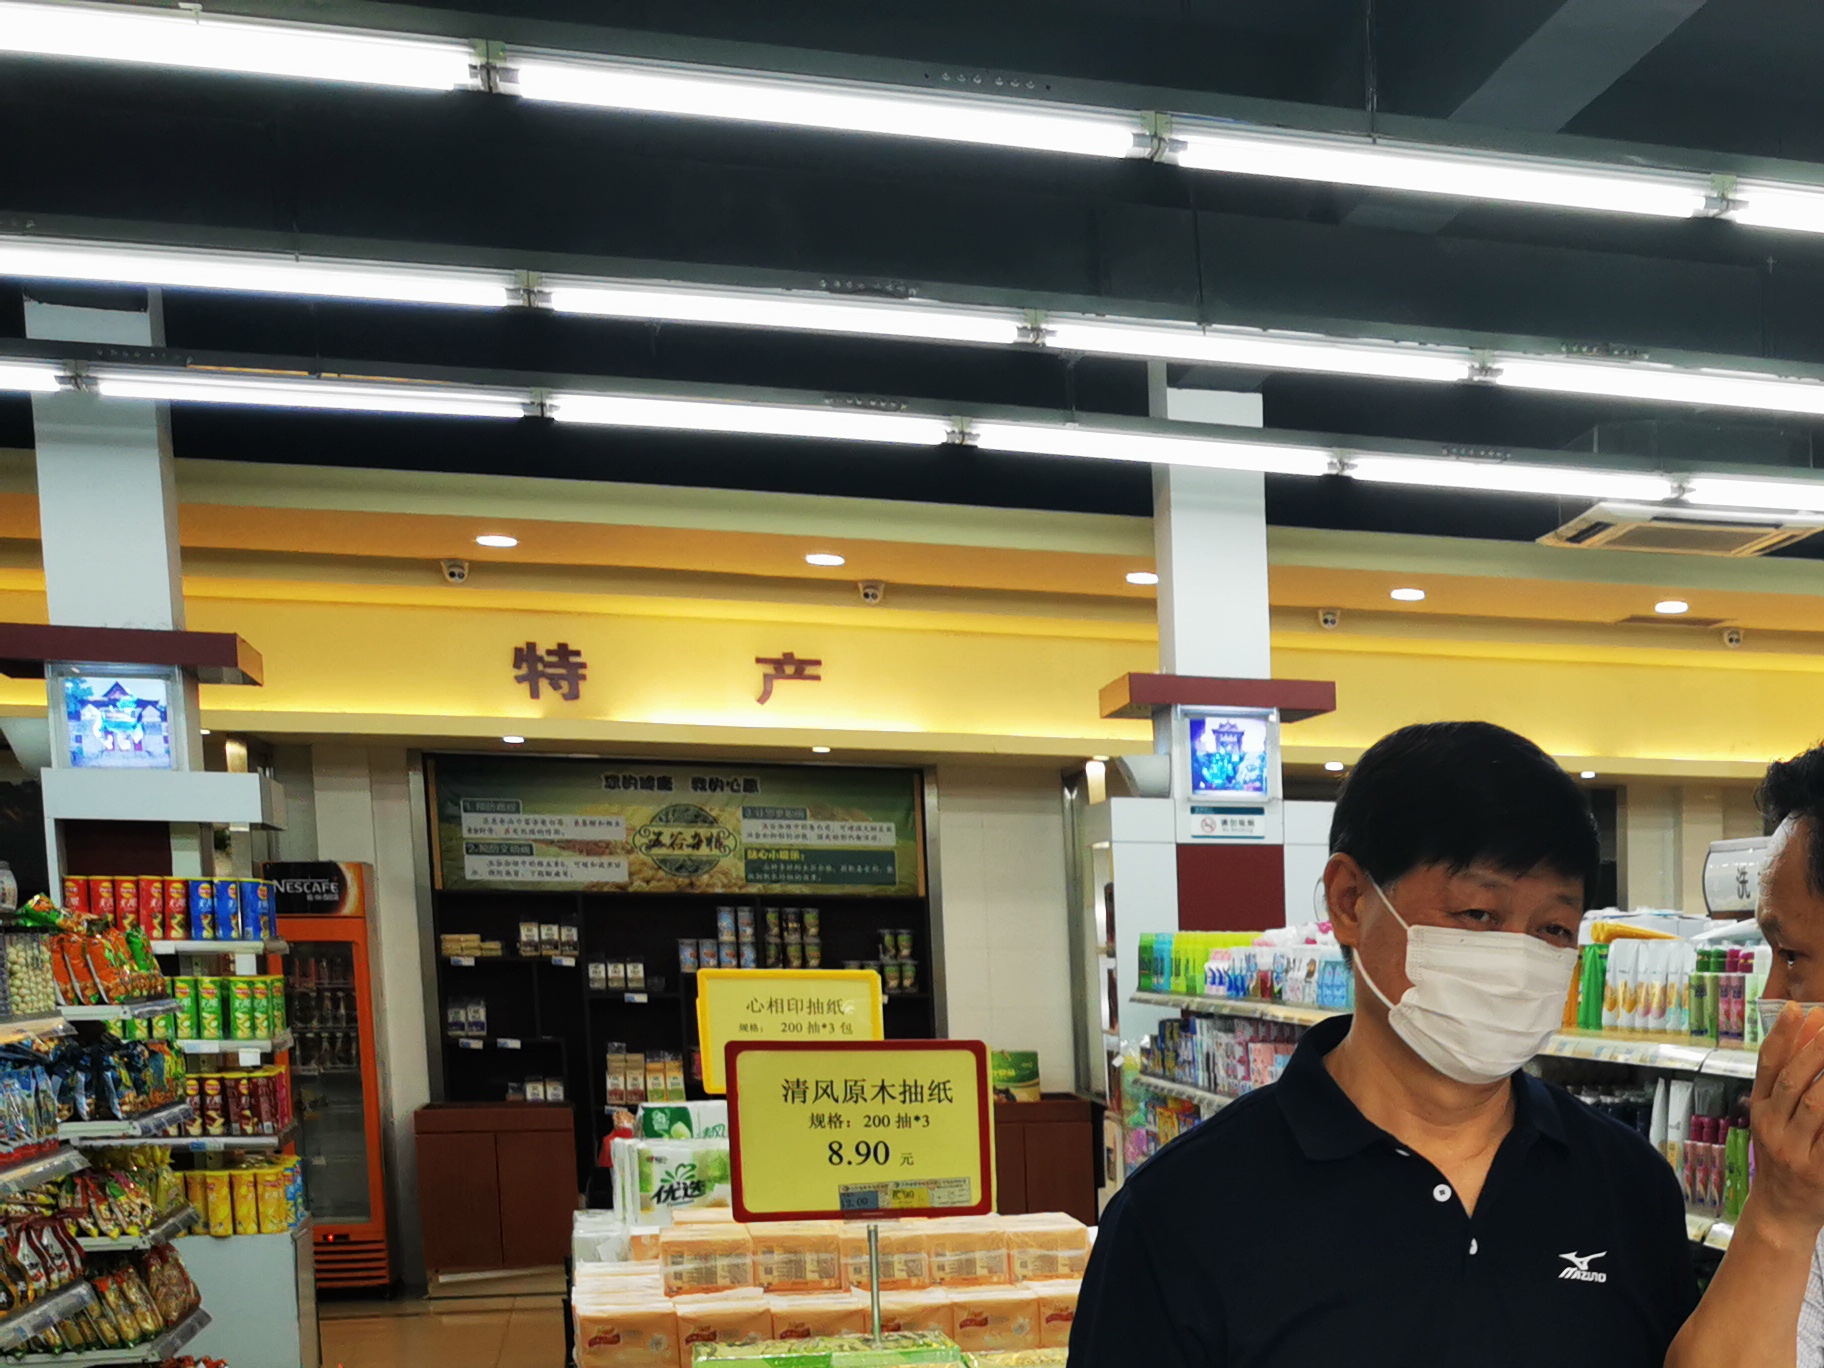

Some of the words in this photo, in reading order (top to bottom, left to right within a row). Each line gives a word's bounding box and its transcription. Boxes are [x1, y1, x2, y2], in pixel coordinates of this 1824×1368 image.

[513, 641, 823, 706] 特产
[746, 996, 846, 1016] 心相印抽纸
[780, 1022, 803, 1033] 200
[781, 1077, 954, 1106] 清风原木抽纸
[863, 1113, 891, 1129] 200
[827, 1139, 890, 1168] 8.90
